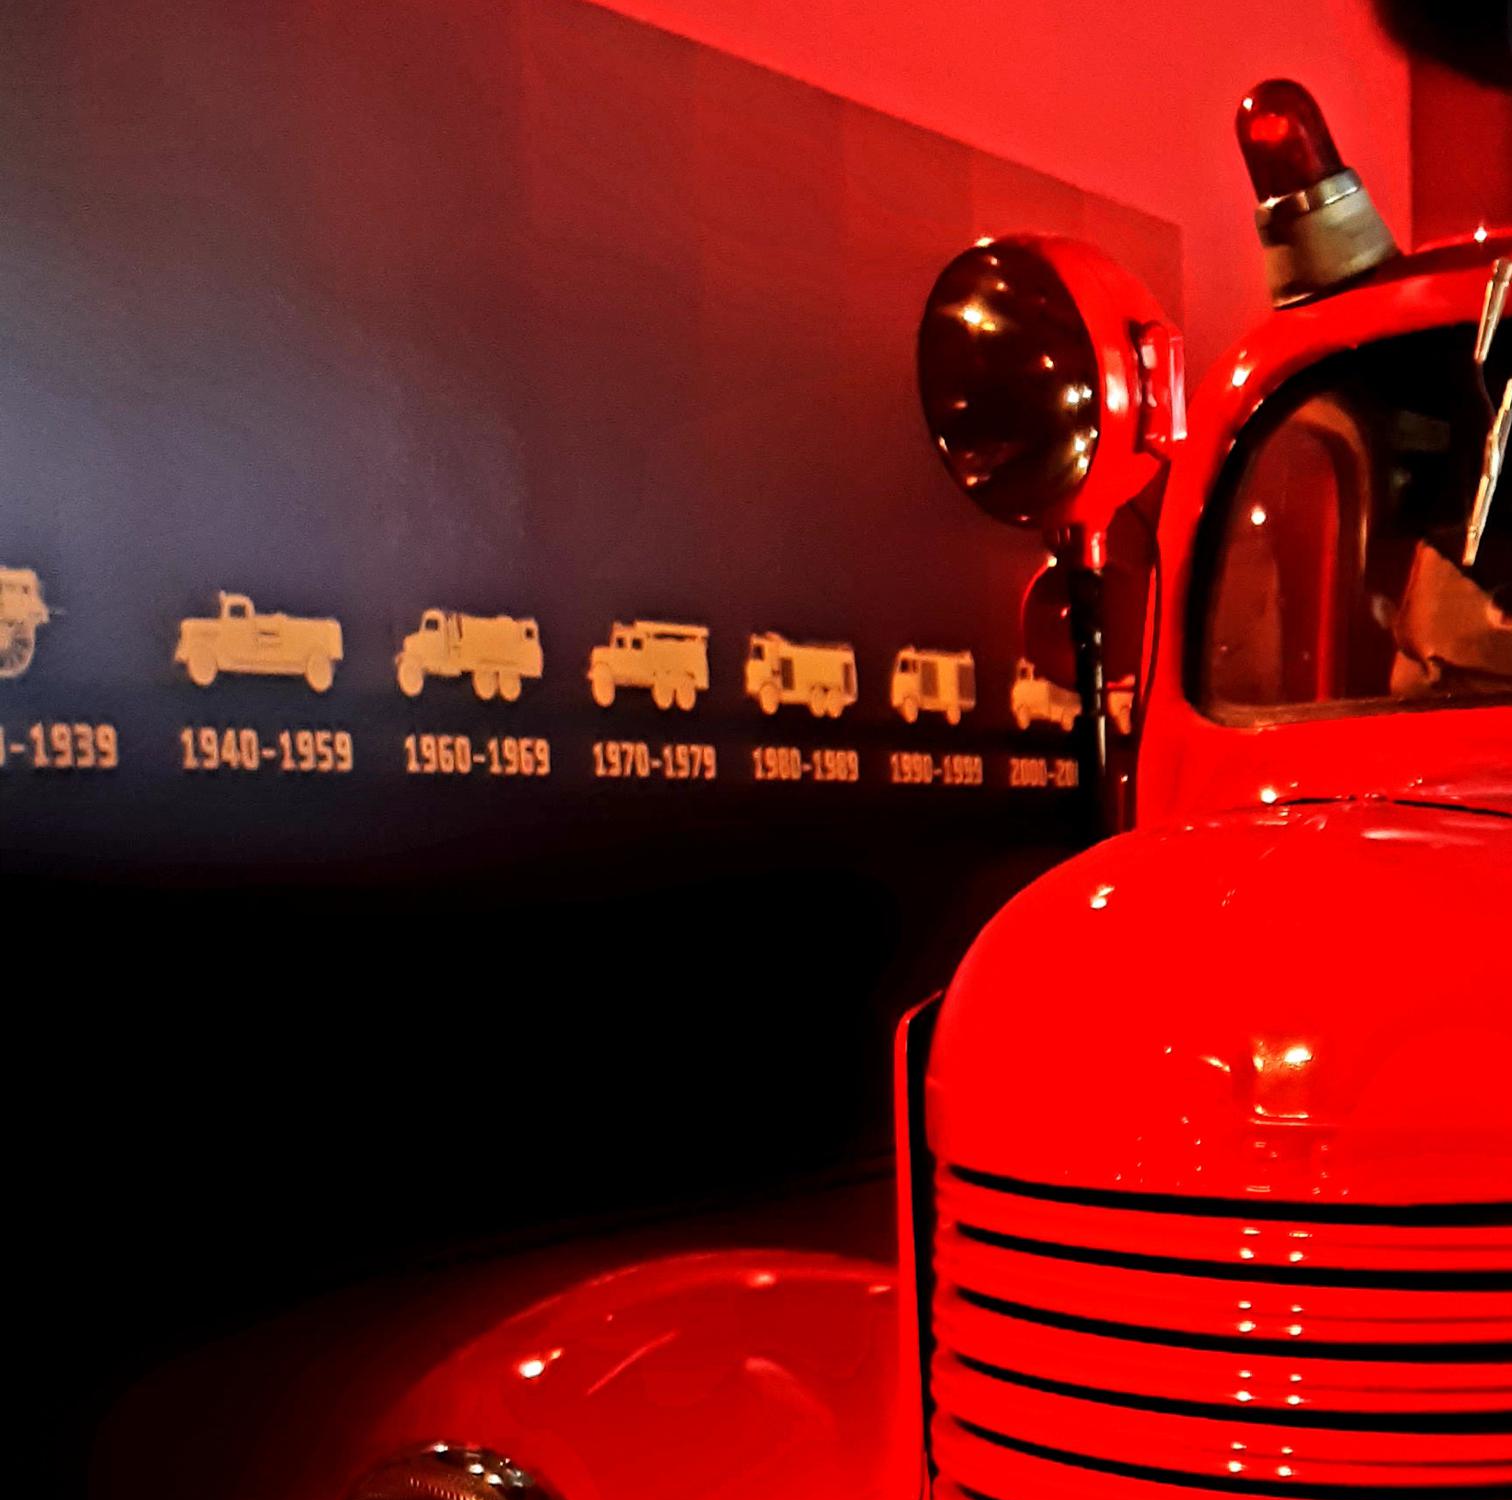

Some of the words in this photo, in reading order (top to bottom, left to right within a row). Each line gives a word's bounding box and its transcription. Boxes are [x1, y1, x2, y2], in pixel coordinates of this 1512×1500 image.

[0, 723, 117, 768] -1939
[181, 727, 353, 772] 1940-1959
[404, 735, 550, 776] 1960-1969
[593, 741, 716, 779] 1970-1979
[752, 747, 859, 781] 1980-1989
[890, 752, 982, 785] 1990-1999
